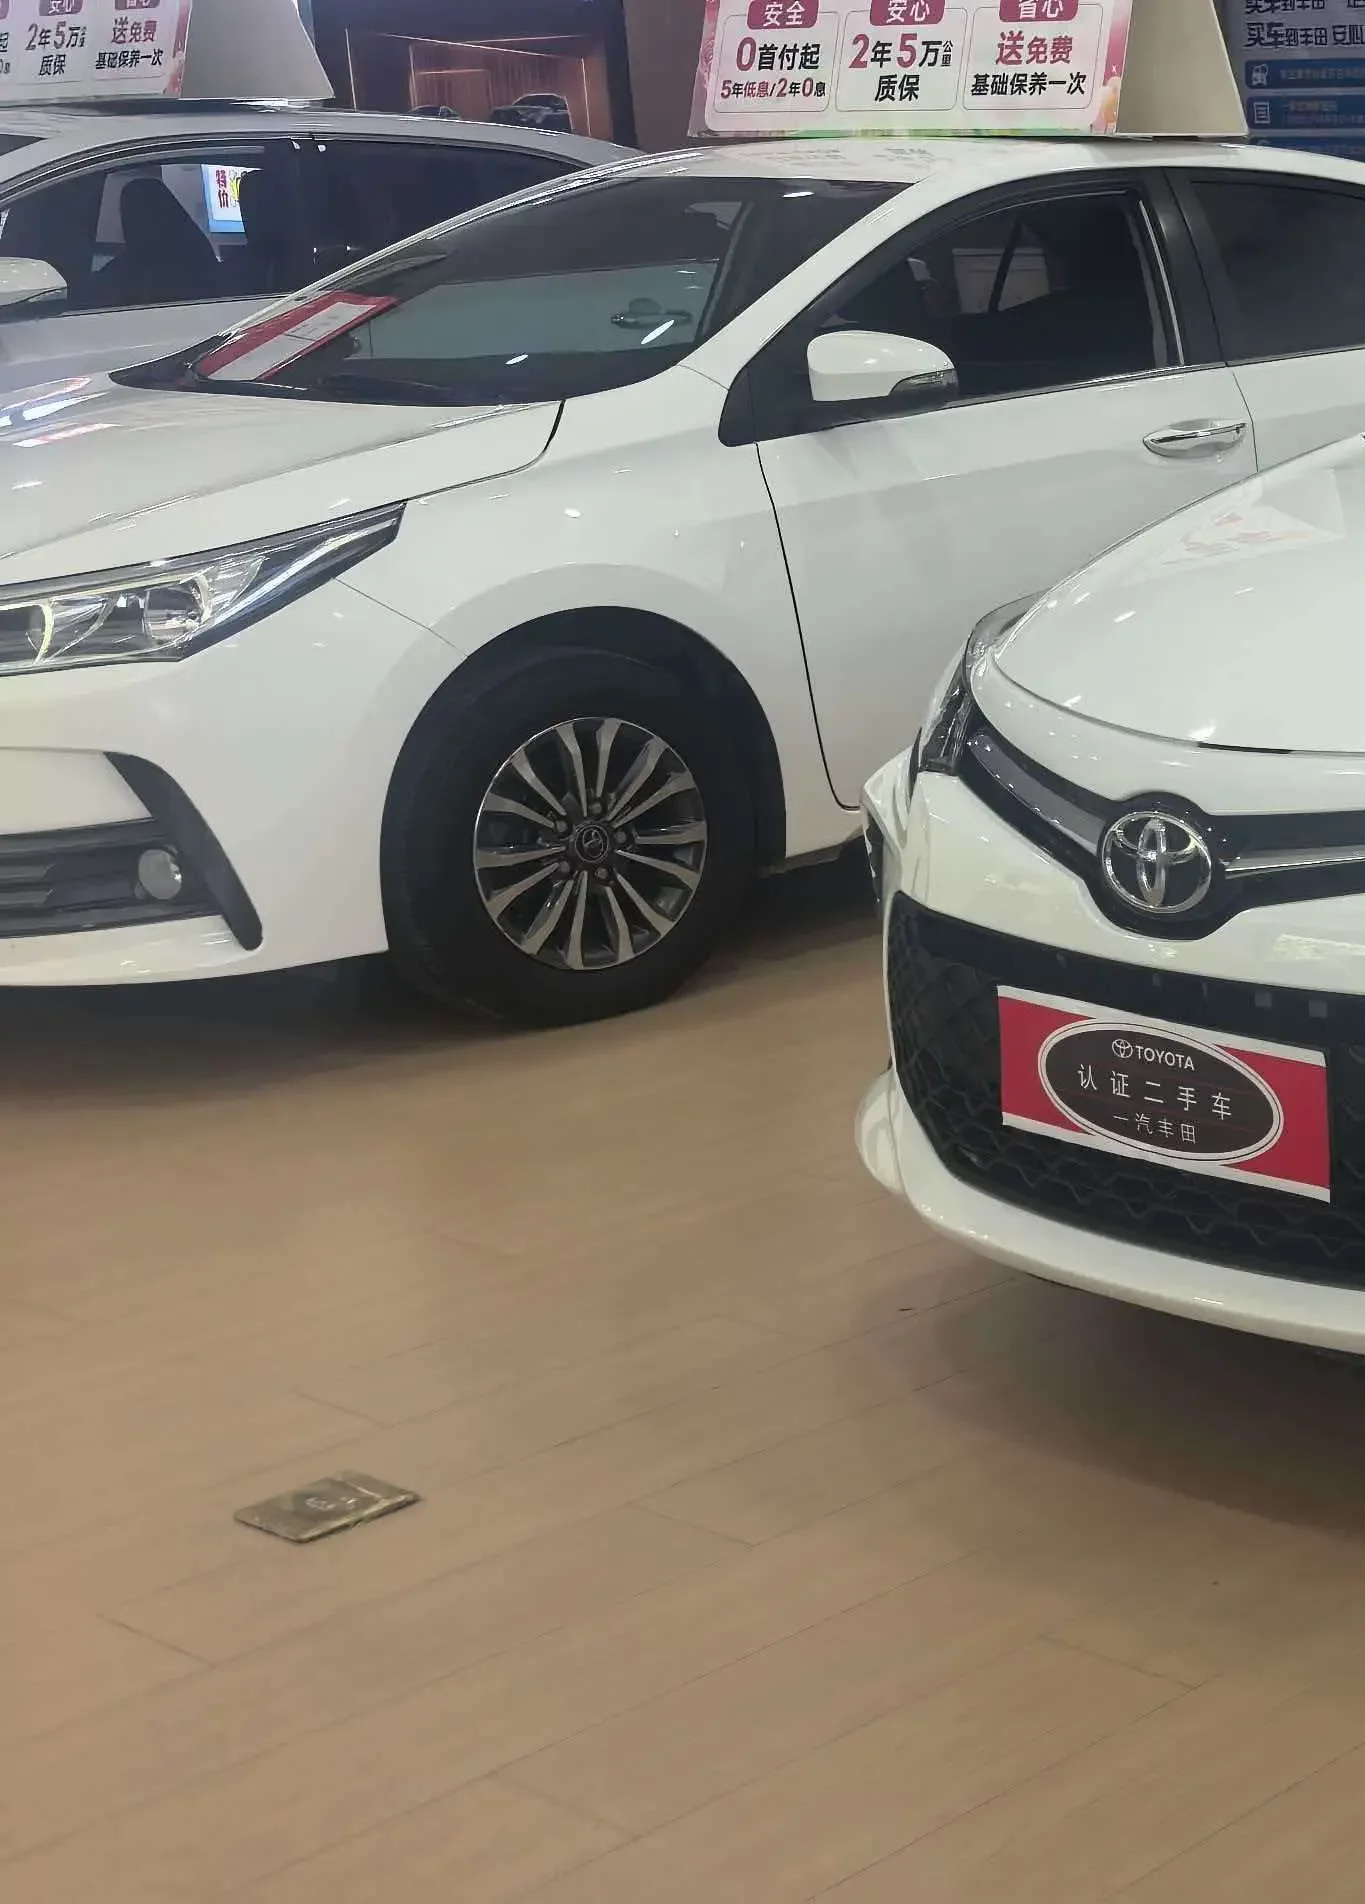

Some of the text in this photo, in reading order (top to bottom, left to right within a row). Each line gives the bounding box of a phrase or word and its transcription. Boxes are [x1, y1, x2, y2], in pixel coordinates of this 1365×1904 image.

[763, 1, 806, 27] 安全
[886, 0, 931, 24] 安心
[95, 49, 164, 70] 基础保养一次
[735, 36, 821, 72] 0首付起
[995, 30, 1074, 66] 送免费
[38, 53, 66, 77] 质保
[720, 77, 827, 99] 5年低息/2年0息
[874, 73, 921, 103] 质保
[970, 71, 1088, 97] 基础保养一次
[1135, 1044, 1196, 1072] TOYOTA
[1076, 1063, 1233, 1121] 认证二手车
[1112, 1112, 1197, 1145] 一汽丰田
